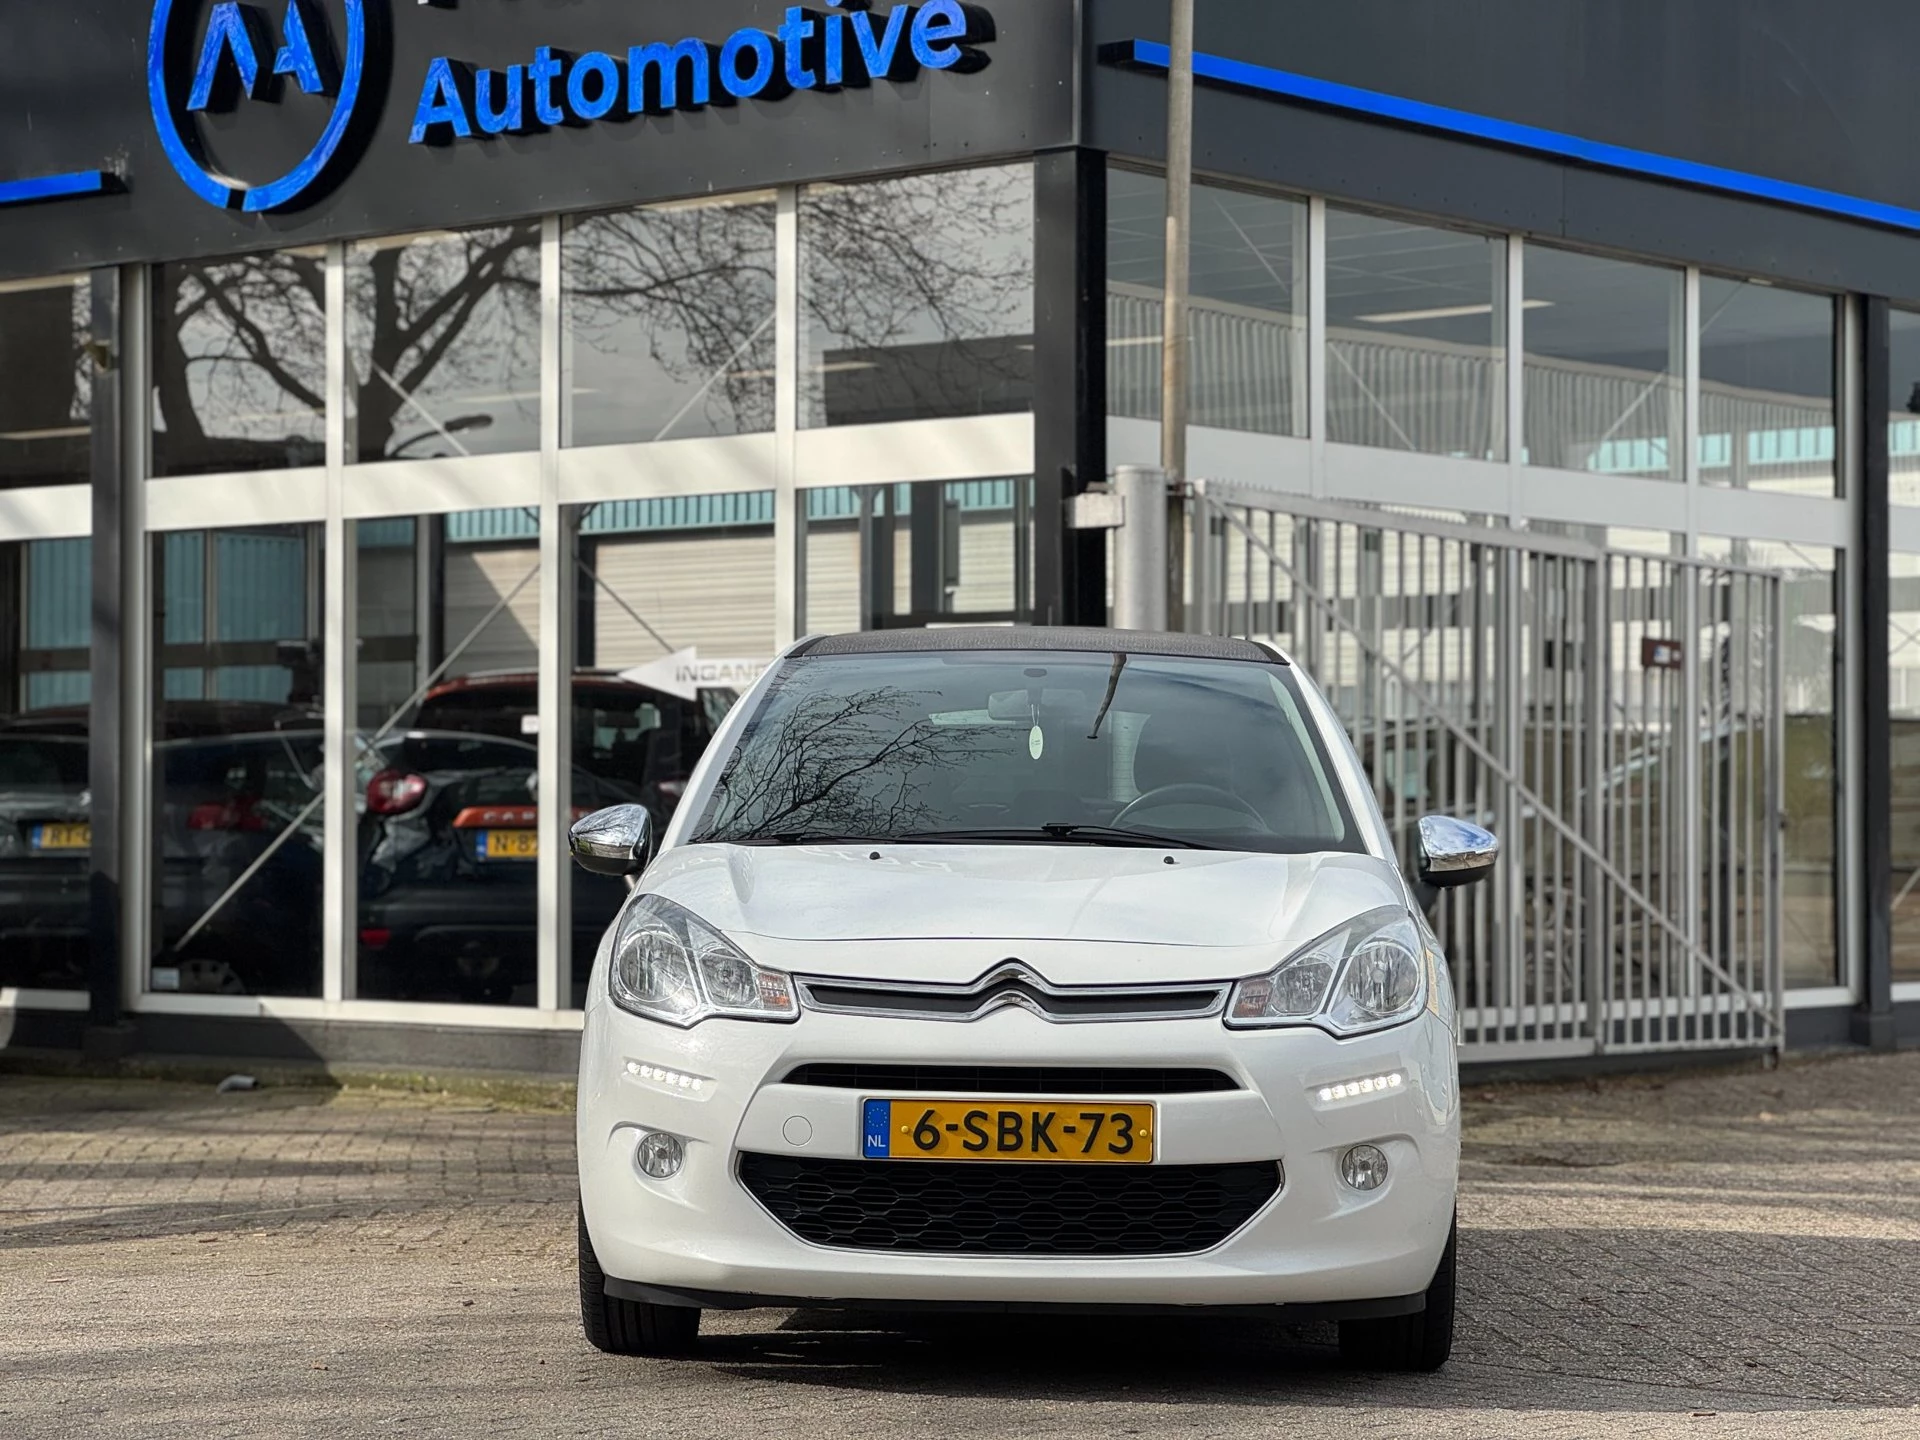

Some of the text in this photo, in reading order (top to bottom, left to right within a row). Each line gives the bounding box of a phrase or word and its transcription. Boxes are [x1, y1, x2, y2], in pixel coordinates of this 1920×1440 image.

[408, 0, 968, 145] Automotive
[867, 1134, 887, 1148] NL
[912, 1109, 1134, 1155] 6-SBK-73
